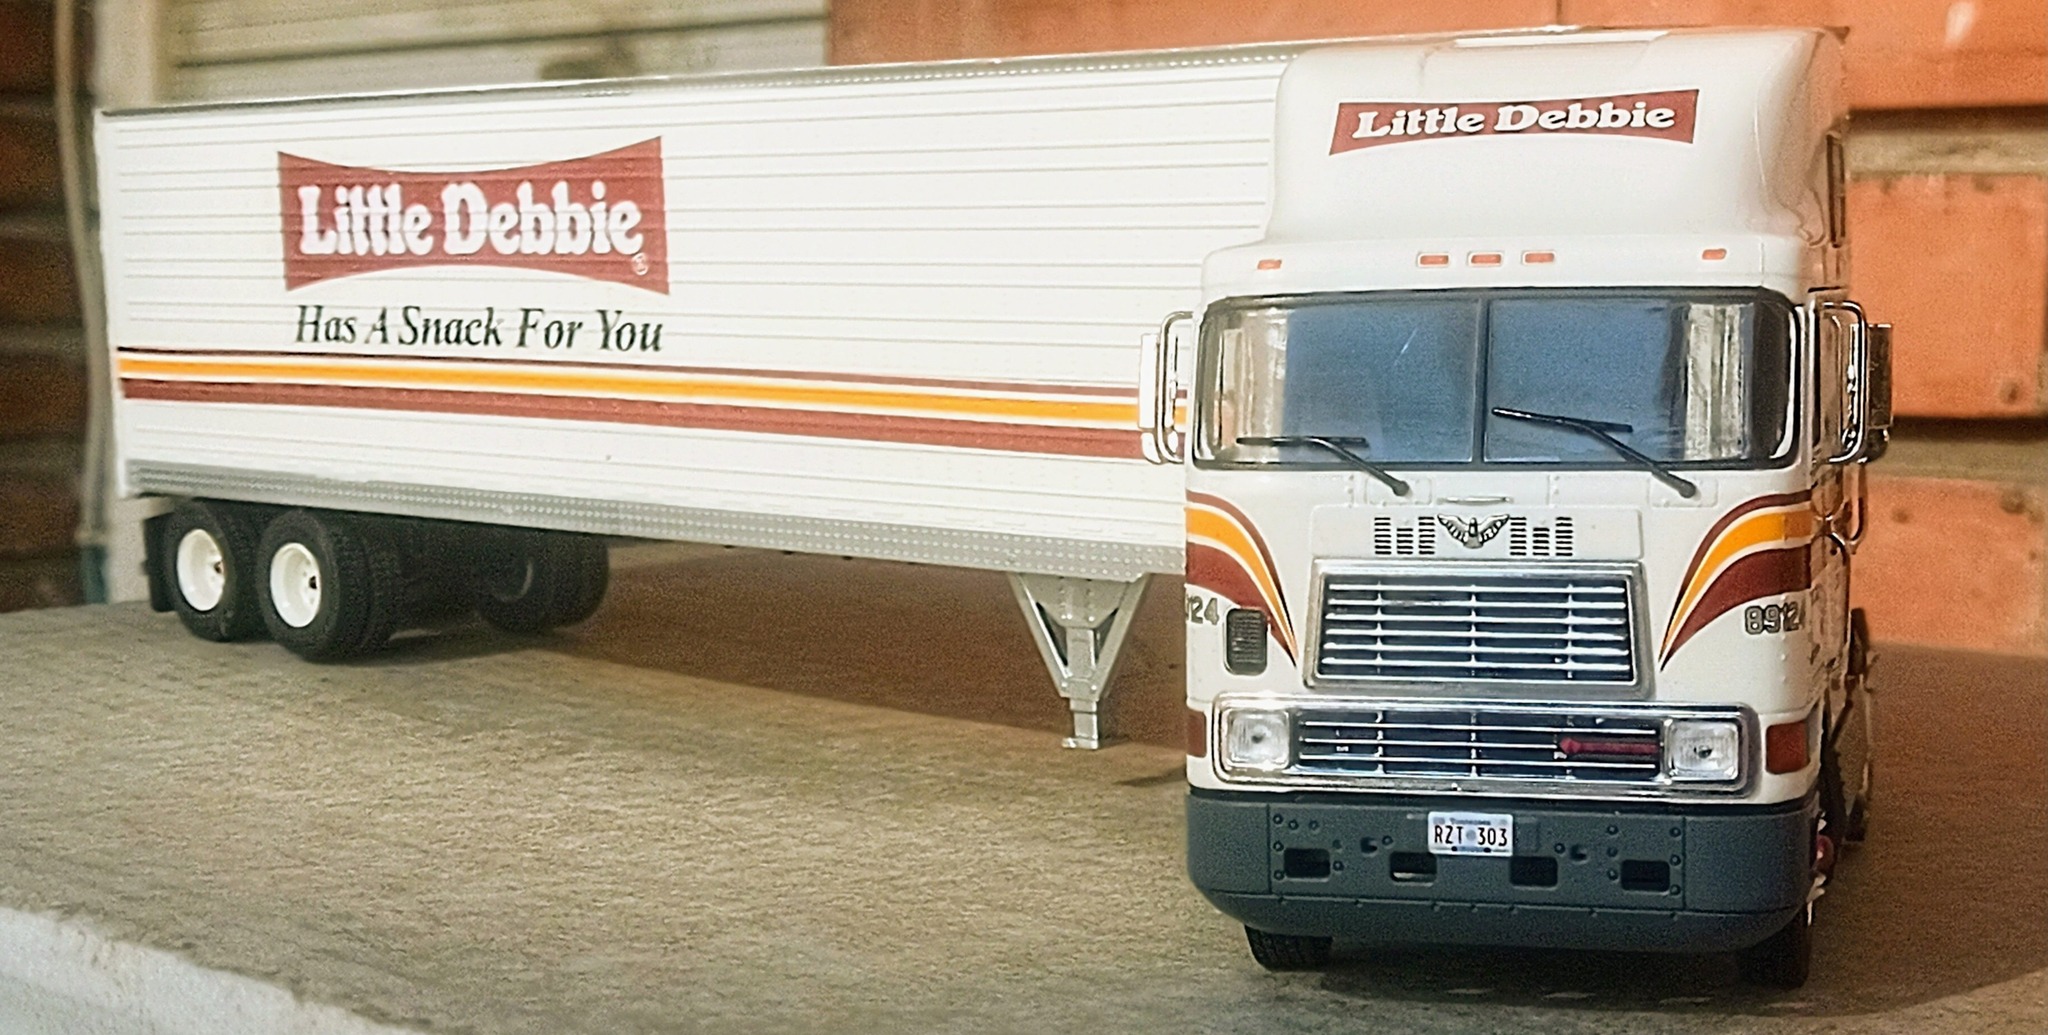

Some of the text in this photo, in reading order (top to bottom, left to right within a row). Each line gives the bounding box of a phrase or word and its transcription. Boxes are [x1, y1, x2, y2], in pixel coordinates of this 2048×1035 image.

[1351, 101, 1675, 138] Little Debbie
[298, 180, 643, 256] Little Debbie
[296, 304, 662, 351] Has A Snack For You
[1434, 824, 1508, 847] RZT 303
